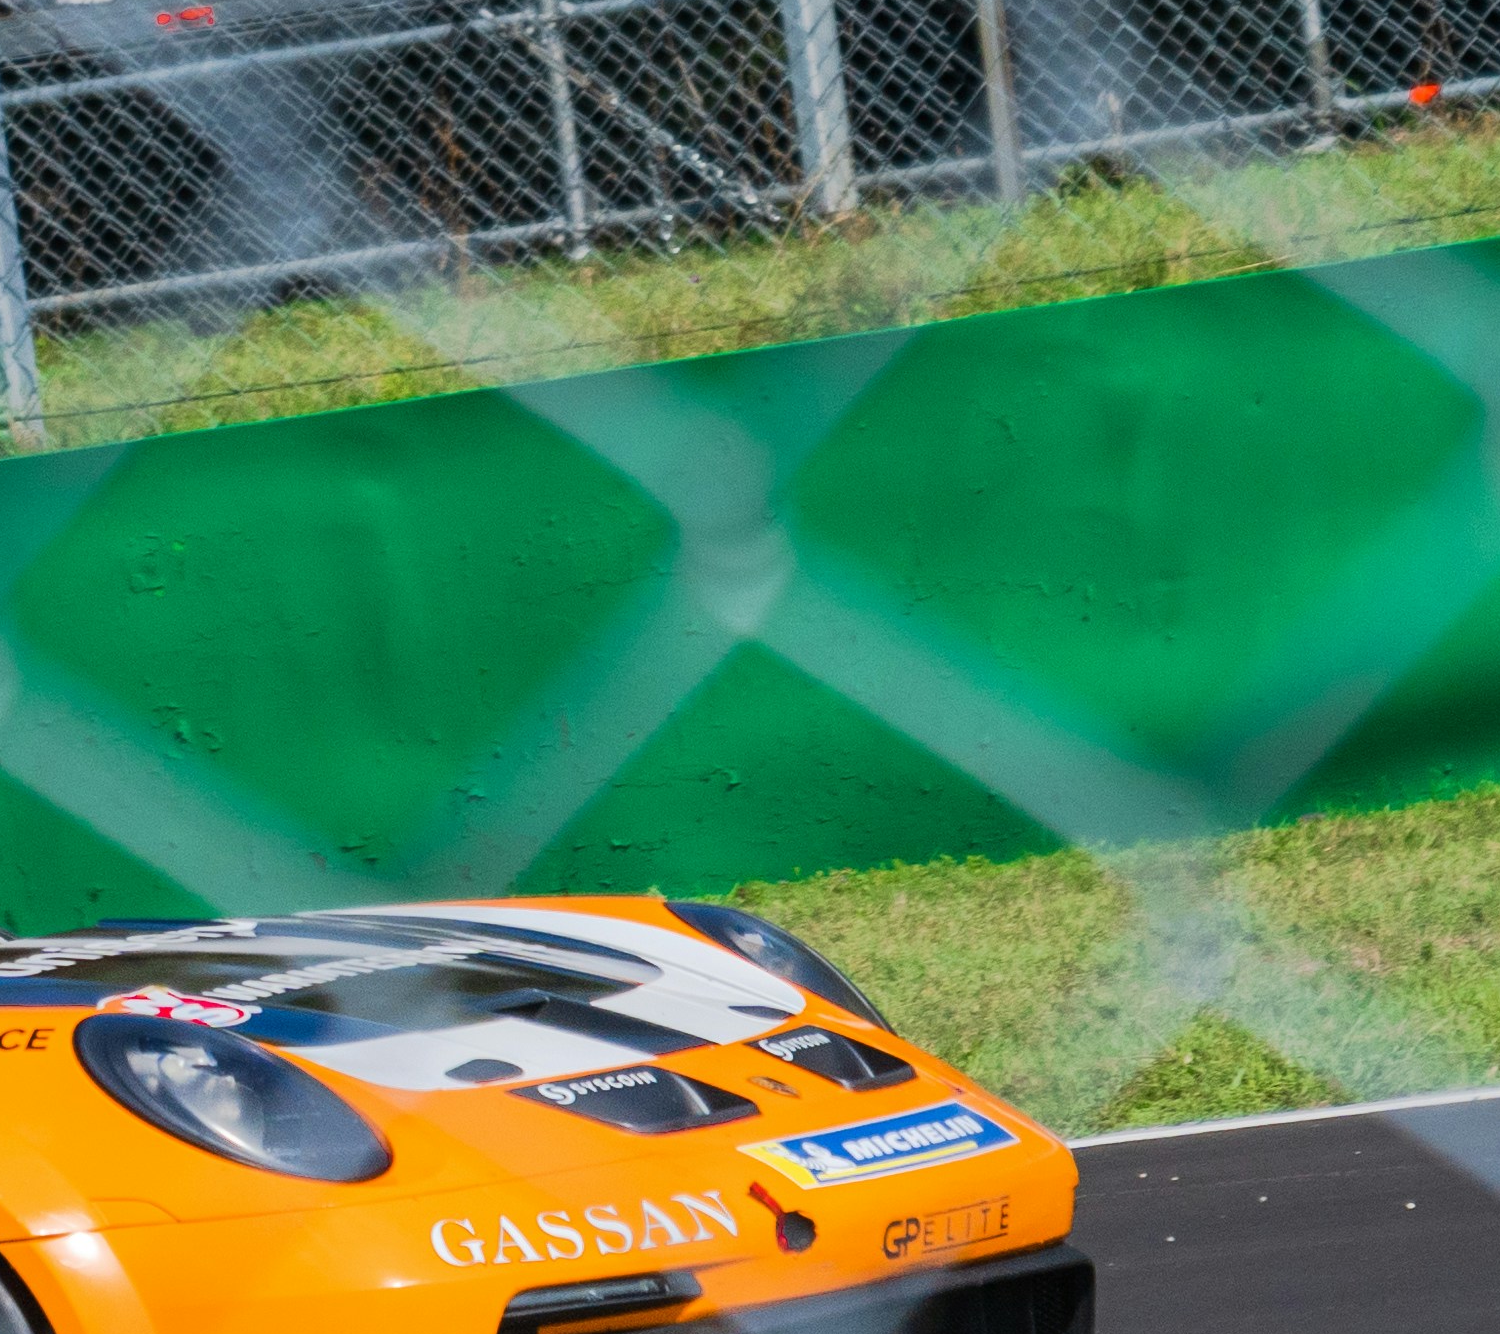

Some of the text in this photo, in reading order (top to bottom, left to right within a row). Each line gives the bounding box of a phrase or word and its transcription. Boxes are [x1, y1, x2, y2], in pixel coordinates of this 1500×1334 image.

[569, 1070, 659, 1096] SYSCOIN
[841, 1114, 985, 1161] MICHELIN
[429, 1189, 740, 1267] GASSAN
[922, 1203, 1010, 1246] ELITE
